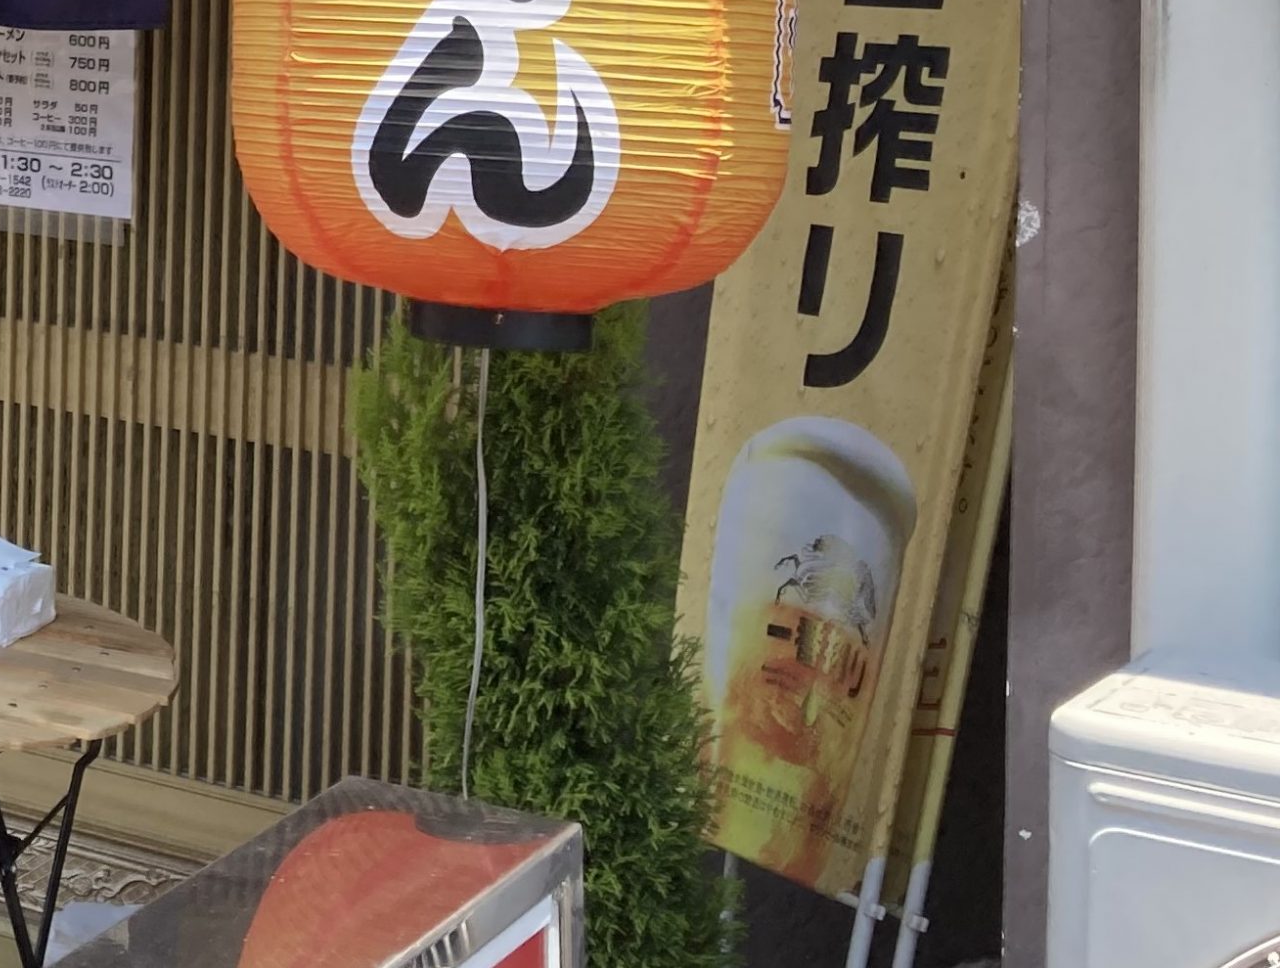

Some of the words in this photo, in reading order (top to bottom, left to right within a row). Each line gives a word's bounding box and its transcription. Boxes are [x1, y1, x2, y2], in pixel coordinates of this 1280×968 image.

[69, 34, 110, 50] 600円
[69, 56, 110, 73] 750円
[69, 79, 110, 95] 800円
[33, 100, 58, 110] サラダ
[32, 113, 62, 123] コーヒー
[71, 162, 114, 180] 2:30
